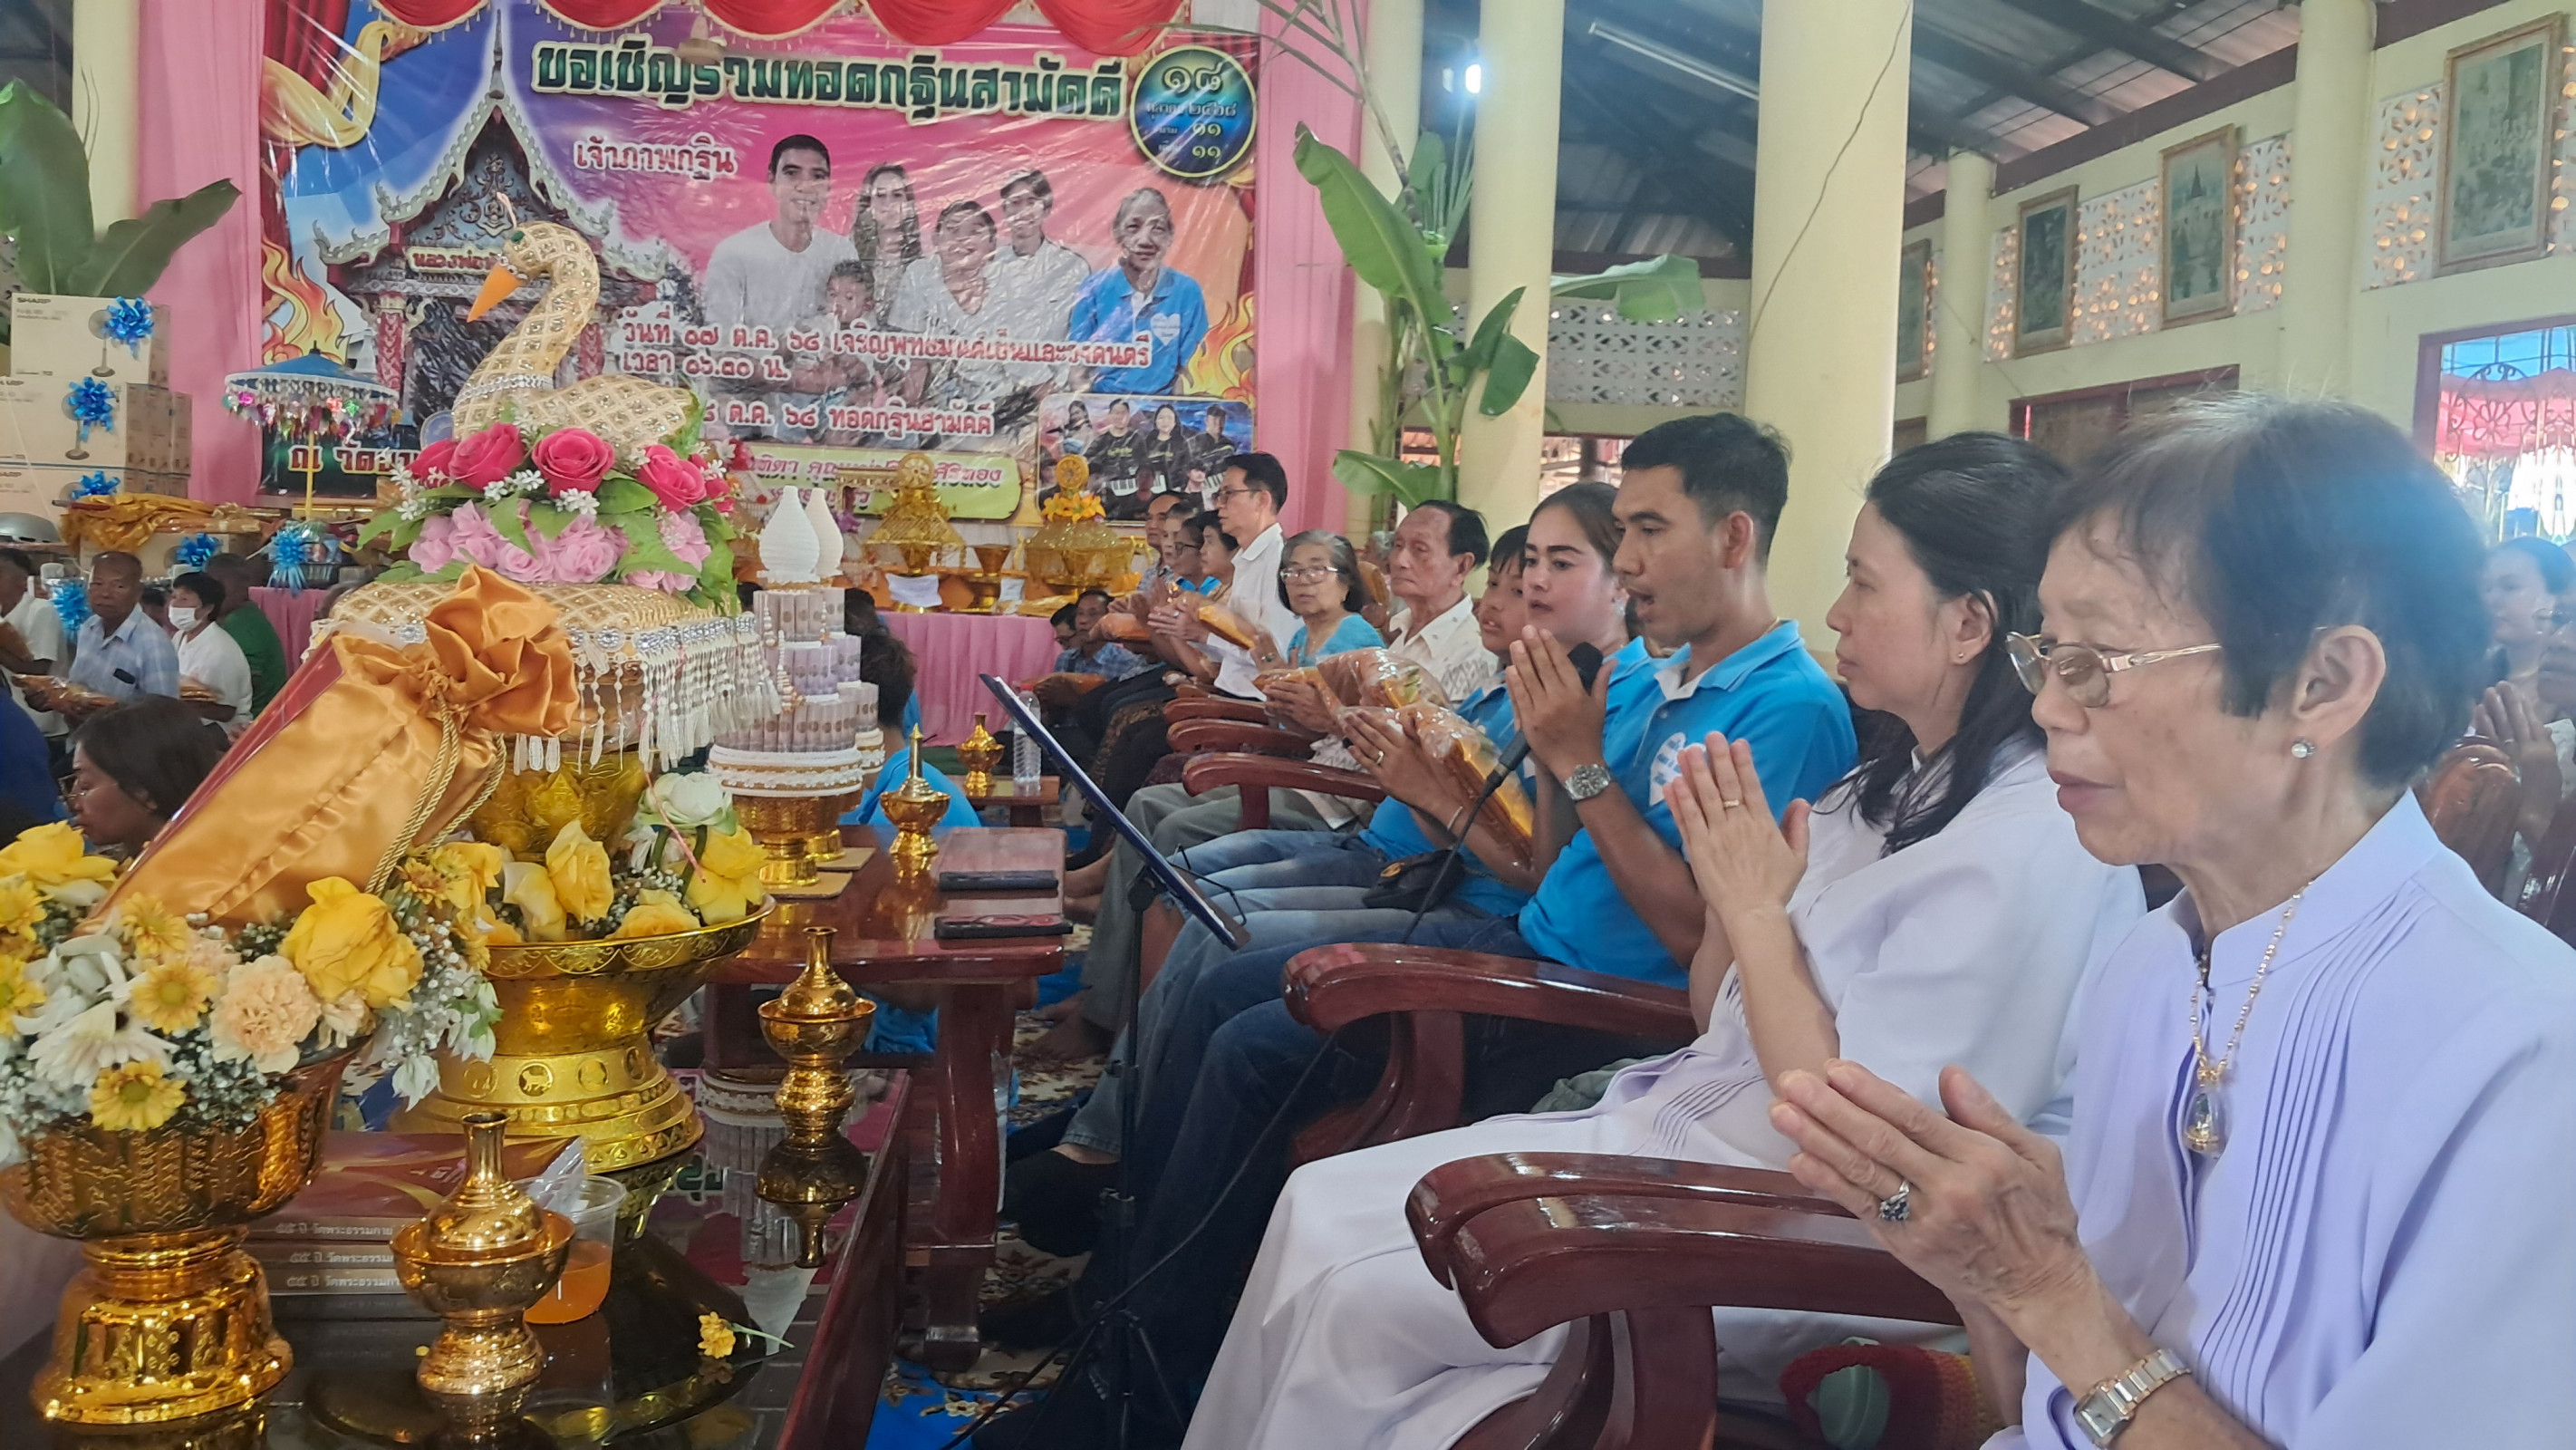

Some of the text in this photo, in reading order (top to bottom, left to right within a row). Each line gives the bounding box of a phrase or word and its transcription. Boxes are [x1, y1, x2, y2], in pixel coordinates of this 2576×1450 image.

[536, 38, 1123, 121] ขอเชิญรวมทอดกฐินสามัคคี
[1163, 63, 1223, 93] ๑๘
[575, 134, 737, 180] เจ้าภาพกฐิน
[1192, 145, 1221, 159] ๑๑
[623, 304, 671, 344] วันที่
[732, 327, 777, 348] ต.ค.
[622, 351, 672, 373] เวลา
[728, 401, 773, 425] ต.ค.
[327, 1251, 394, 1263] วัดพระธรรม
[325, 1275, 401, 1287] วัดพระธรรมกา
